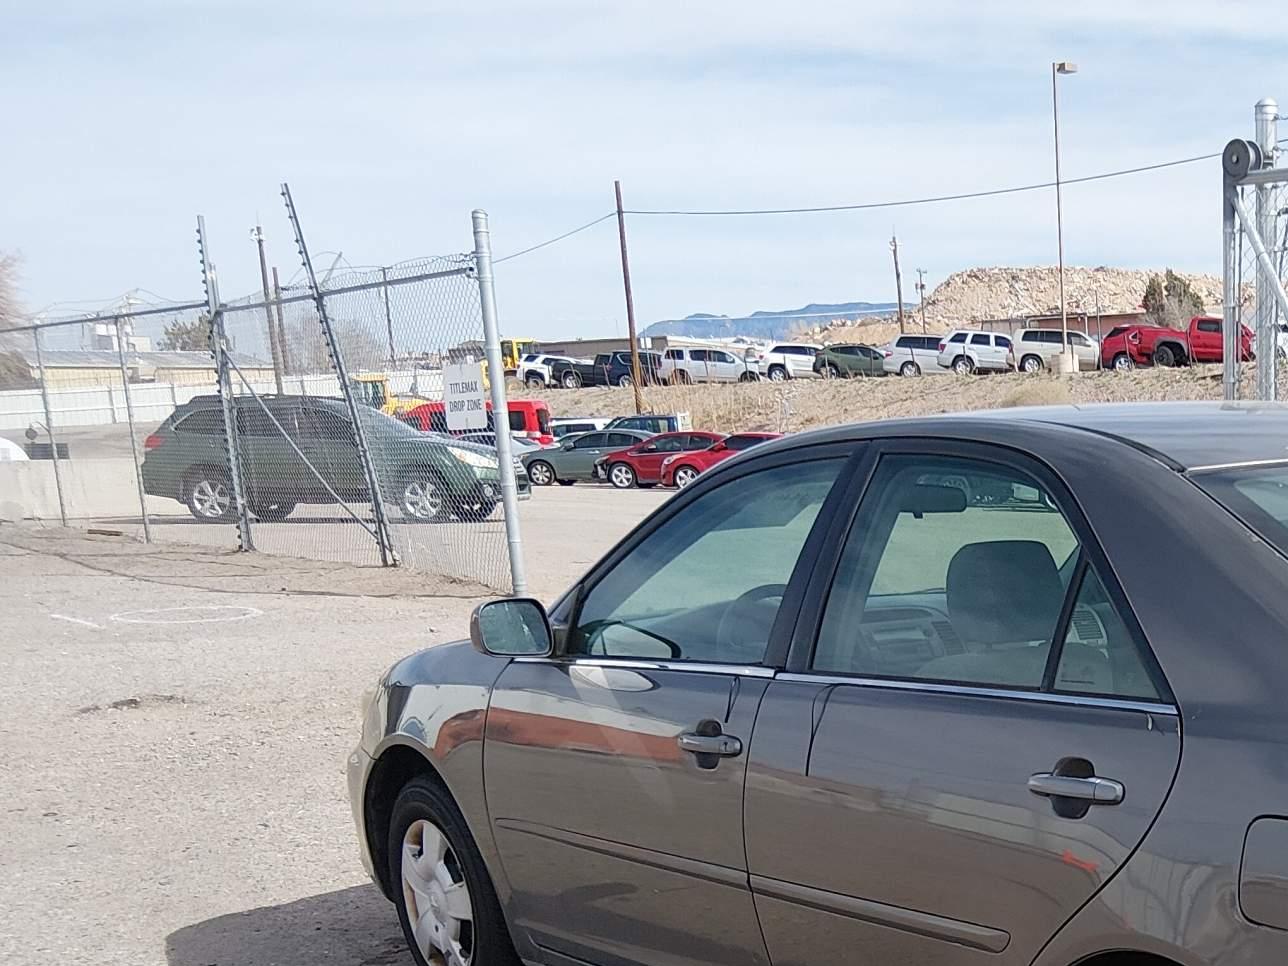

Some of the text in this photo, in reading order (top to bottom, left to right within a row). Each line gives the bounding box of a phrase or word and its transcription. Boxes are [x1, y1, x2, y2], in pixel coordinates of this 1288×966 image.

[449, 381, 479, 394] TITLEMAX
[449, 399, 482, 412] DROP ZONE
